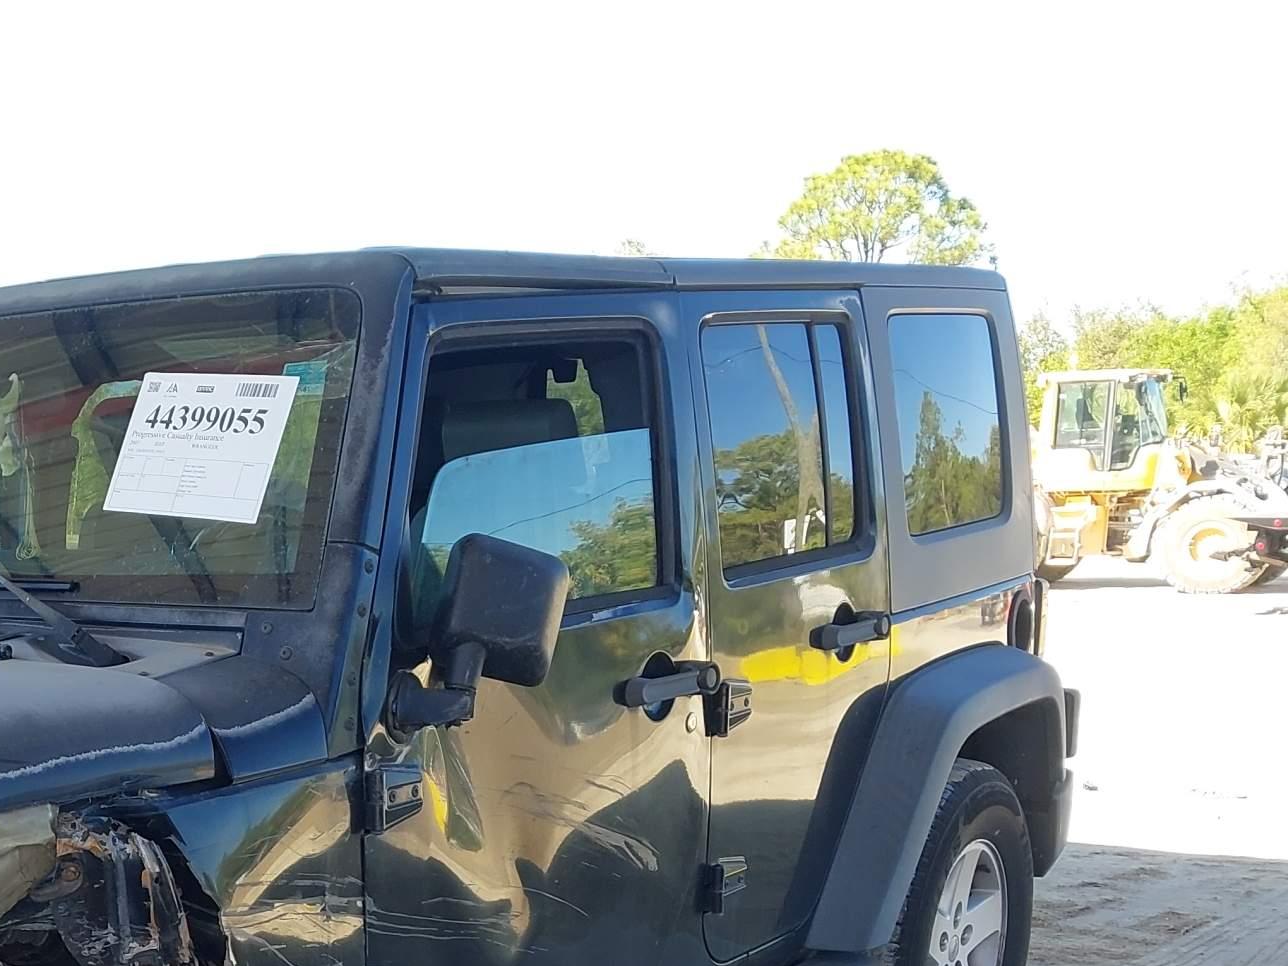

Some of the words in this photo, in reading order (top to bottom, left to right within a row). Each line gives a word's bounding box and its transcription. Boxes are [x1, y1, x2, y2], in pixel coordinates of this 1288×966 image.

[145, 404, 269, 435] 44399055
[131, 431, 166, 443] Progressive
[166, 432, 194, 443] Casualty
[194, 433, 224, 443] Insurance
